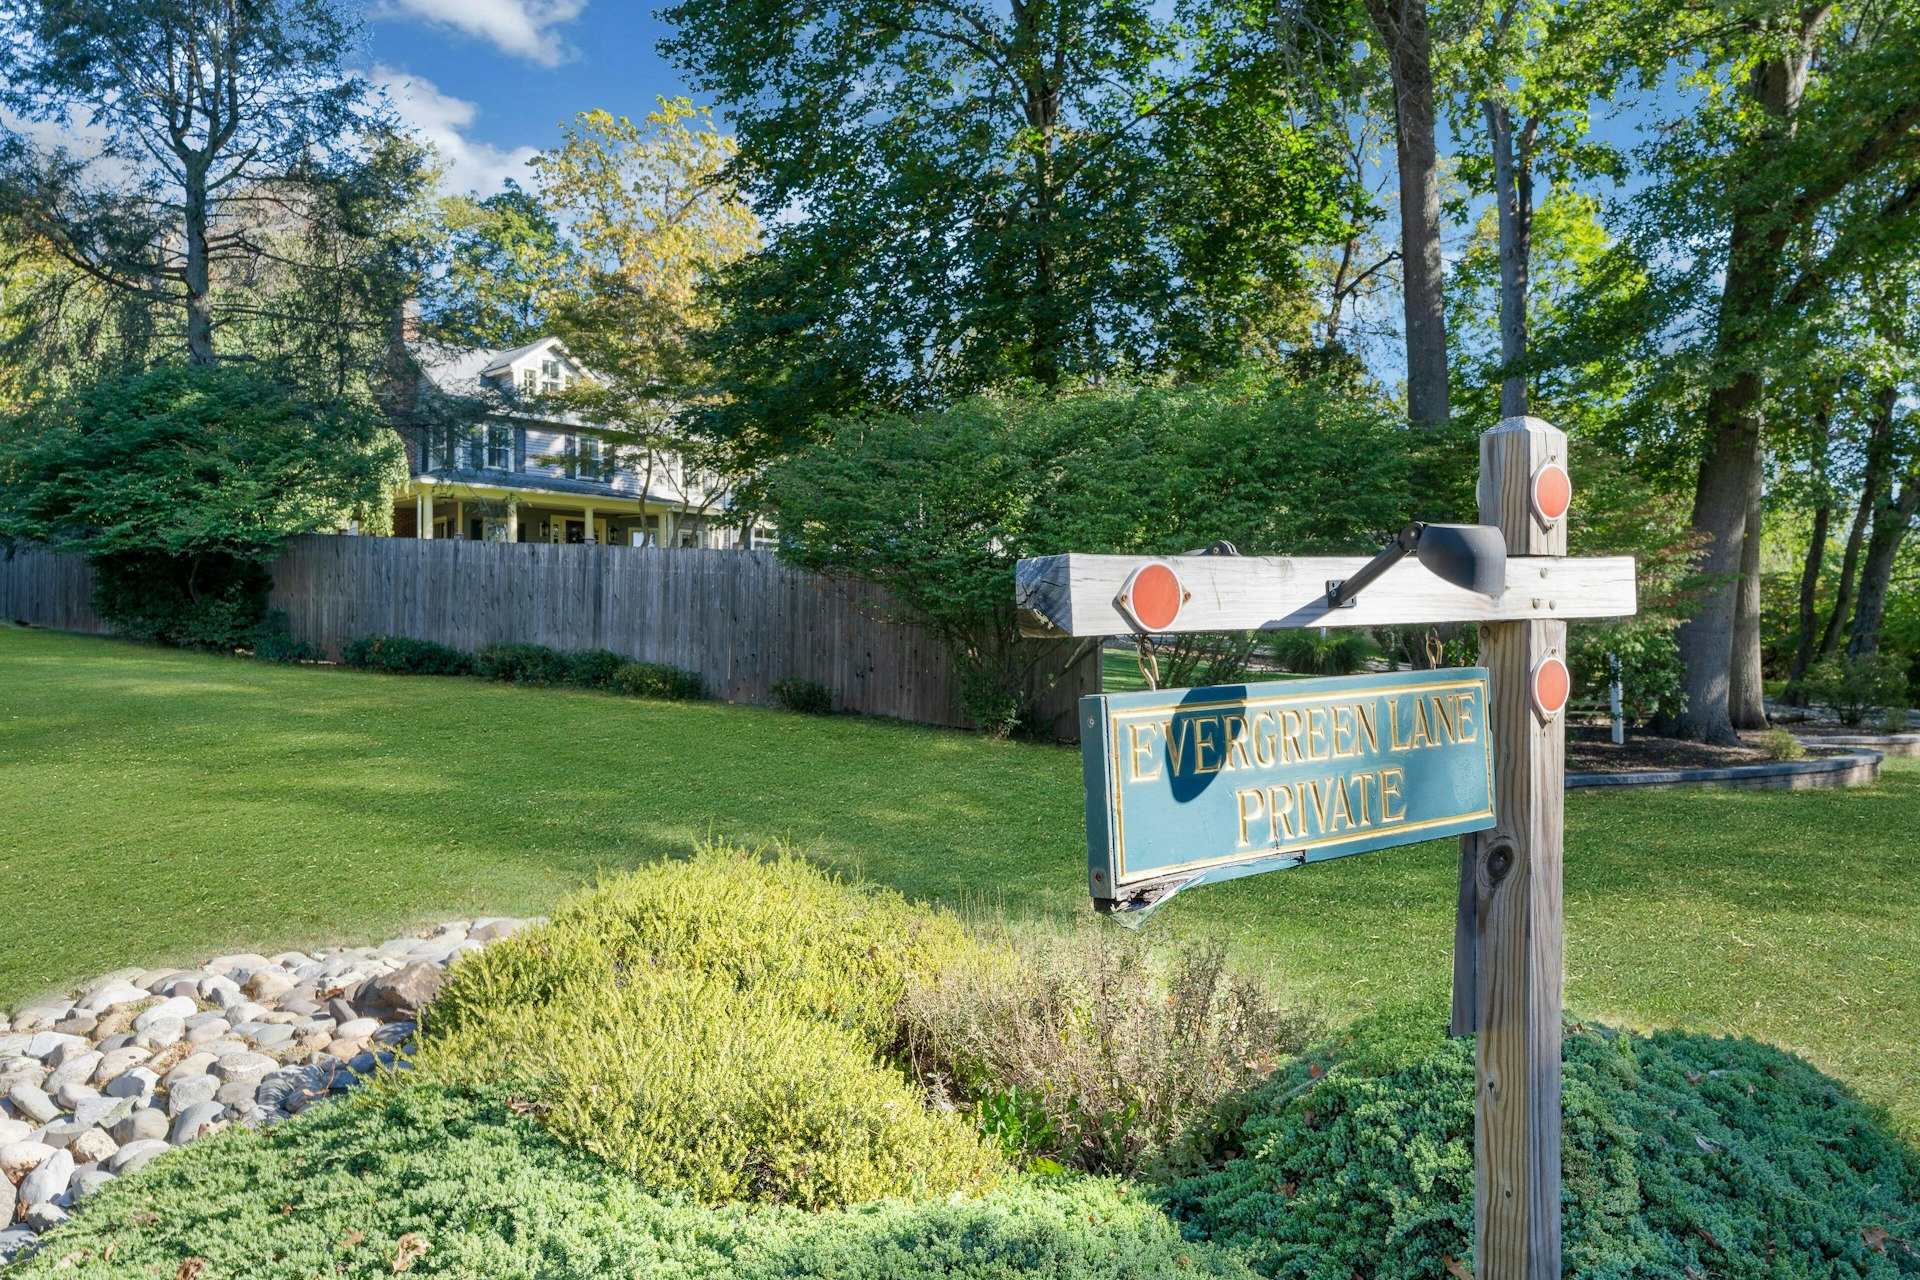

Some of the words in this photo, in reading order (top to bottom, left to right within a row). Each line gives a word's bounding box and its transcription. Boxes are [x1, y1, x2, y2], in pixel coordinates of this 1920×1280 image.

[1127, 702, 1379, 783] EVERGREEN
[1387, 693, 1477, 751] LANE
[1235, 768, 1406, 847] PRIVATE
